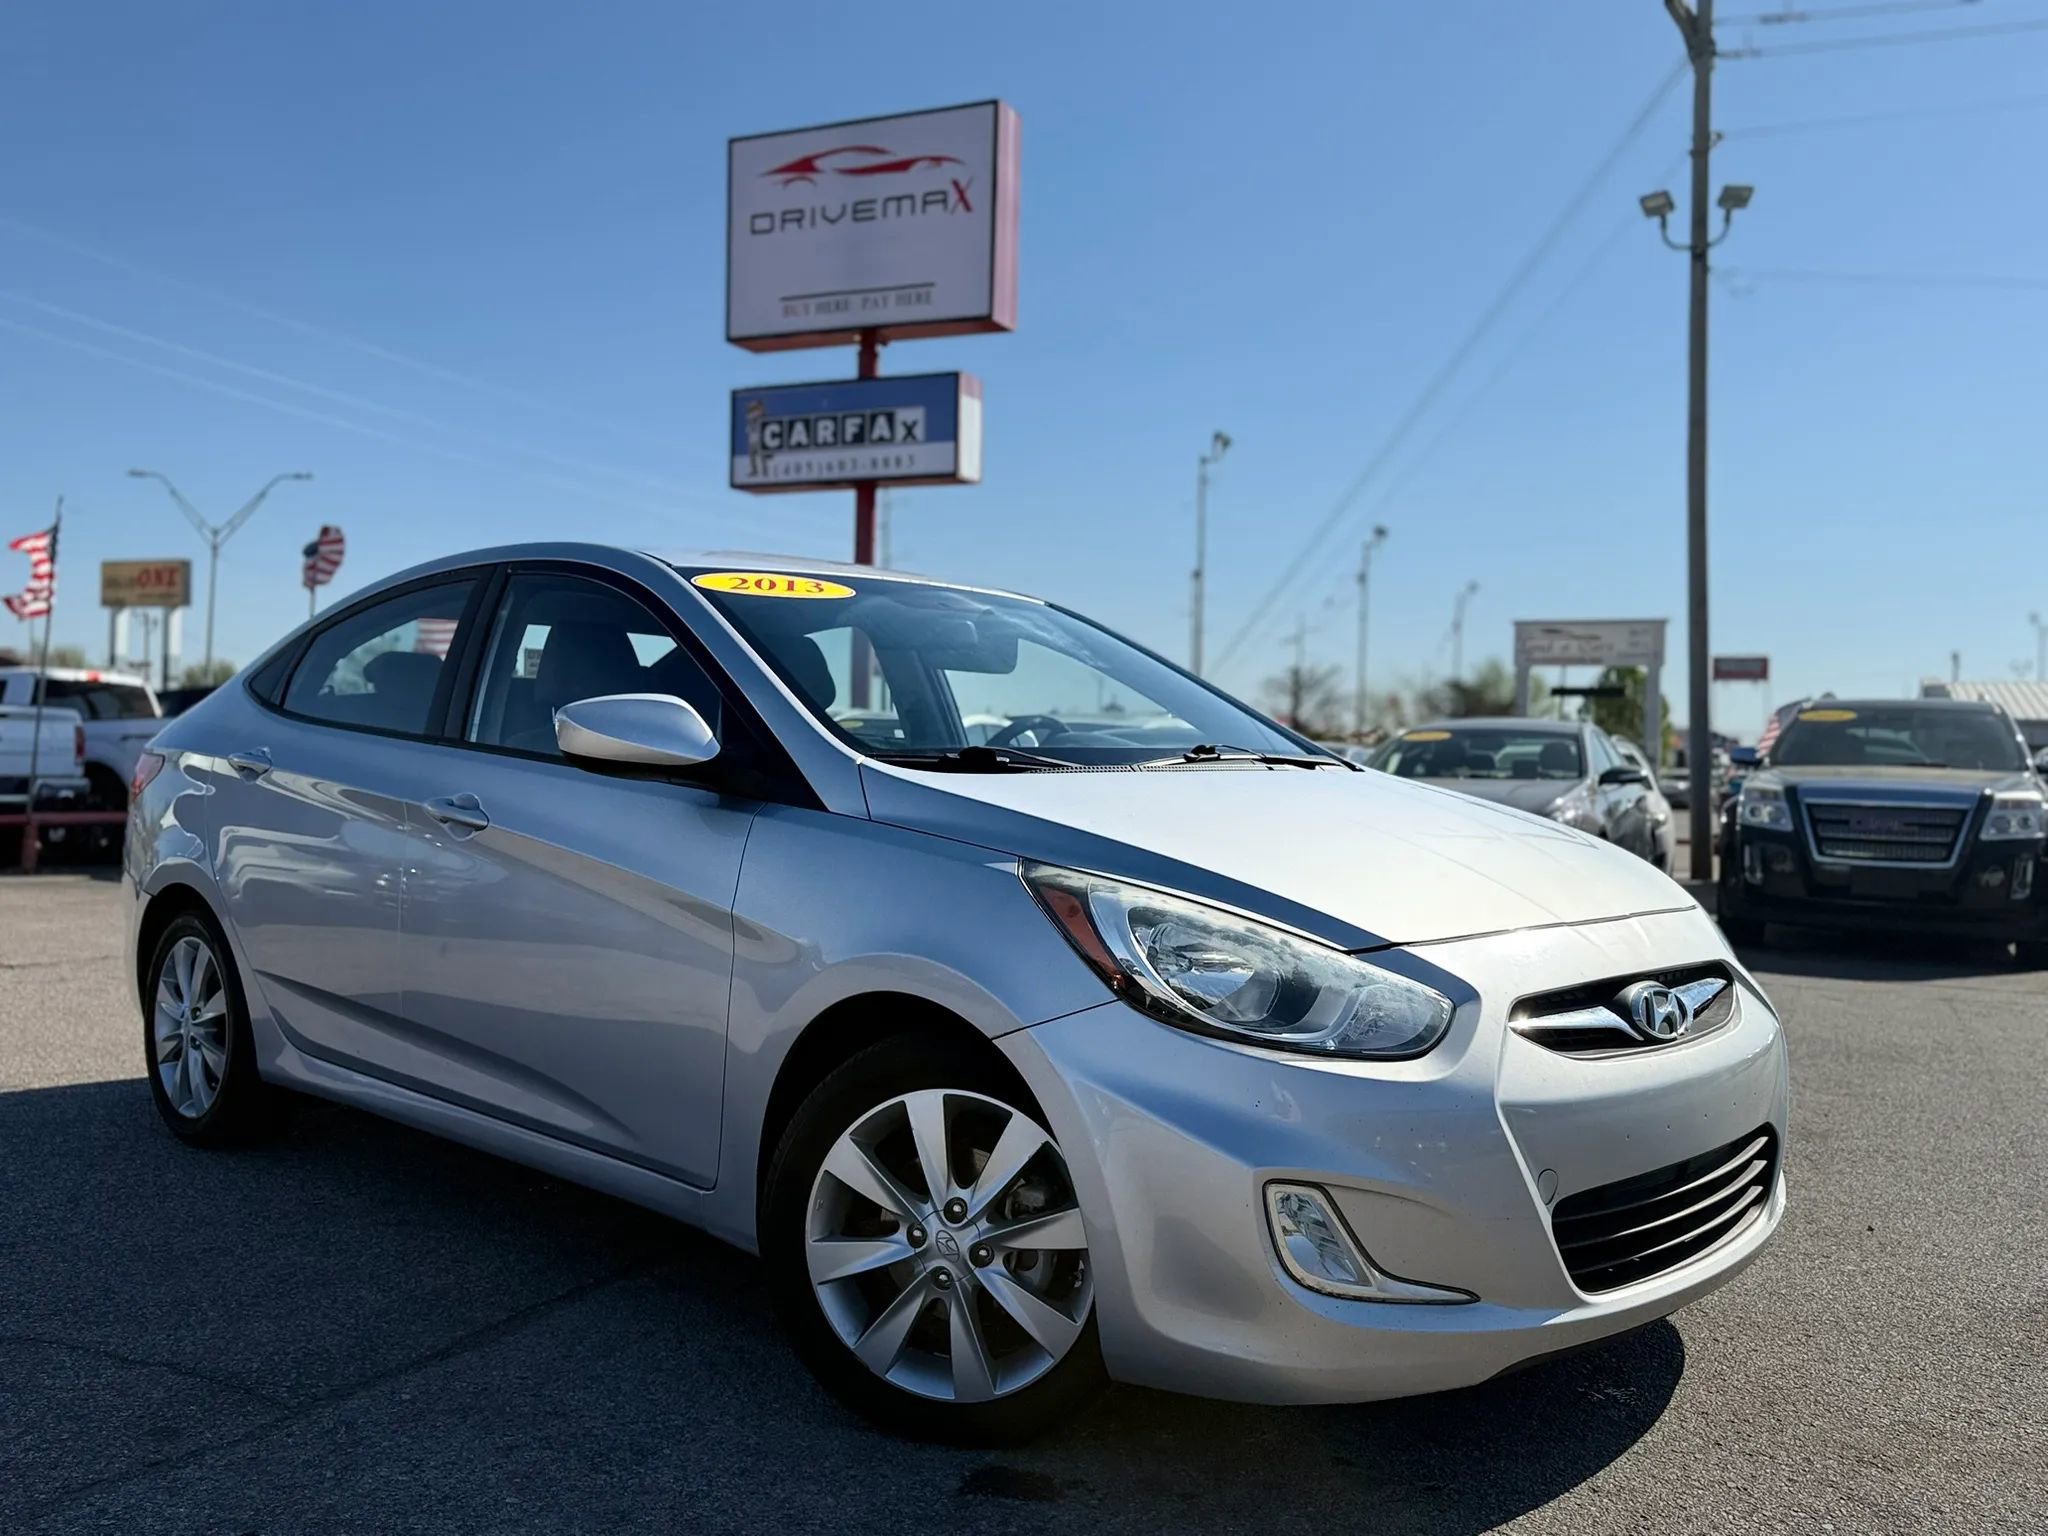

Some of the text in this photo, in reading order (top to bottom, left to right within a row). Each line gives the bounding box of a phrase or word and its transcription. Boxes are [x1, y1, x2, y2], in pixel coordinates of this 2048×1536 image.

[750, 177, 974, 235] DRIVEMAX
[814, 297, 850, 316] HERE
[861, 294, 888, 311] PAY
[895, 289, 932, 306] HERE
[762, 410, 919, 448] CARFAX
[728, 577, 824, 593] 2013
